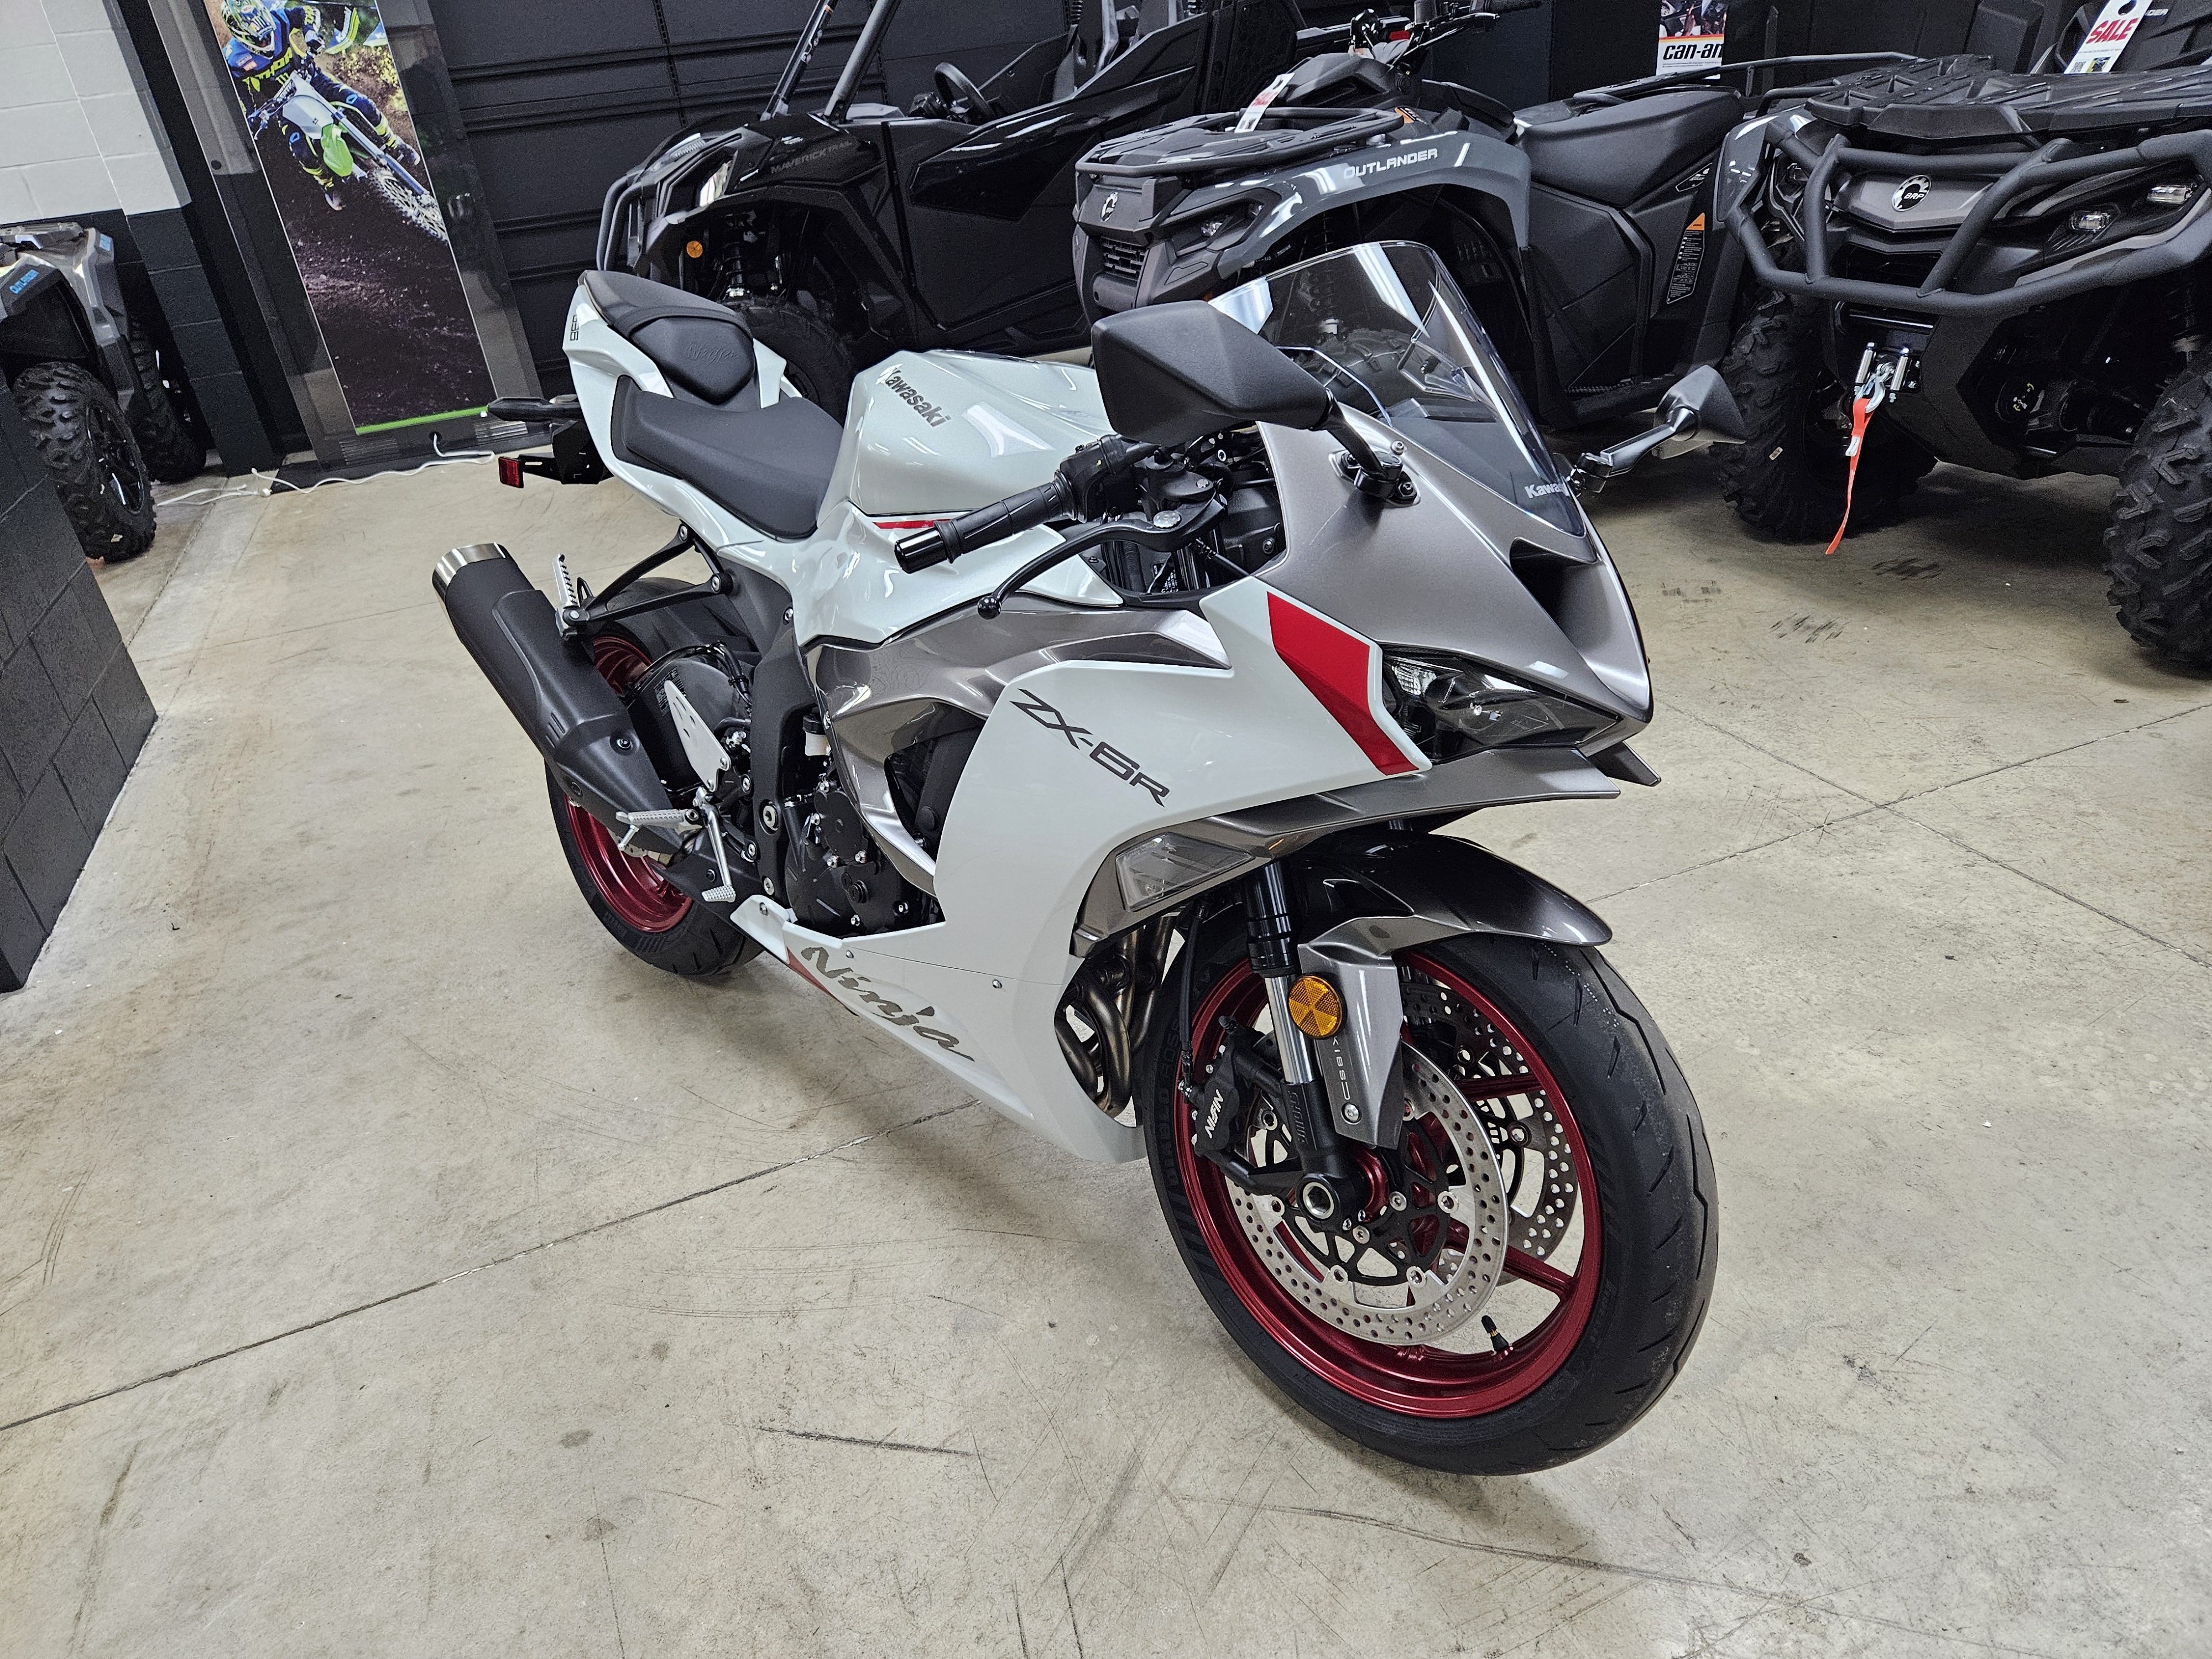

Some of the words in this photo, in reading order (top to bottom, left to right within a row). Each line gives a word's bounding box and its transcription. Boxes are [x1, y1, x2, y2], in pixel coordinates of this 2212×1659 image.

[2085, 17, 2140, 44] SALE
[1343, 148, 1438, 179] OUTLANDER
[1009, 688, 1170, 808] ZX-6R
[801, 946, 975, 1062] Ninja
